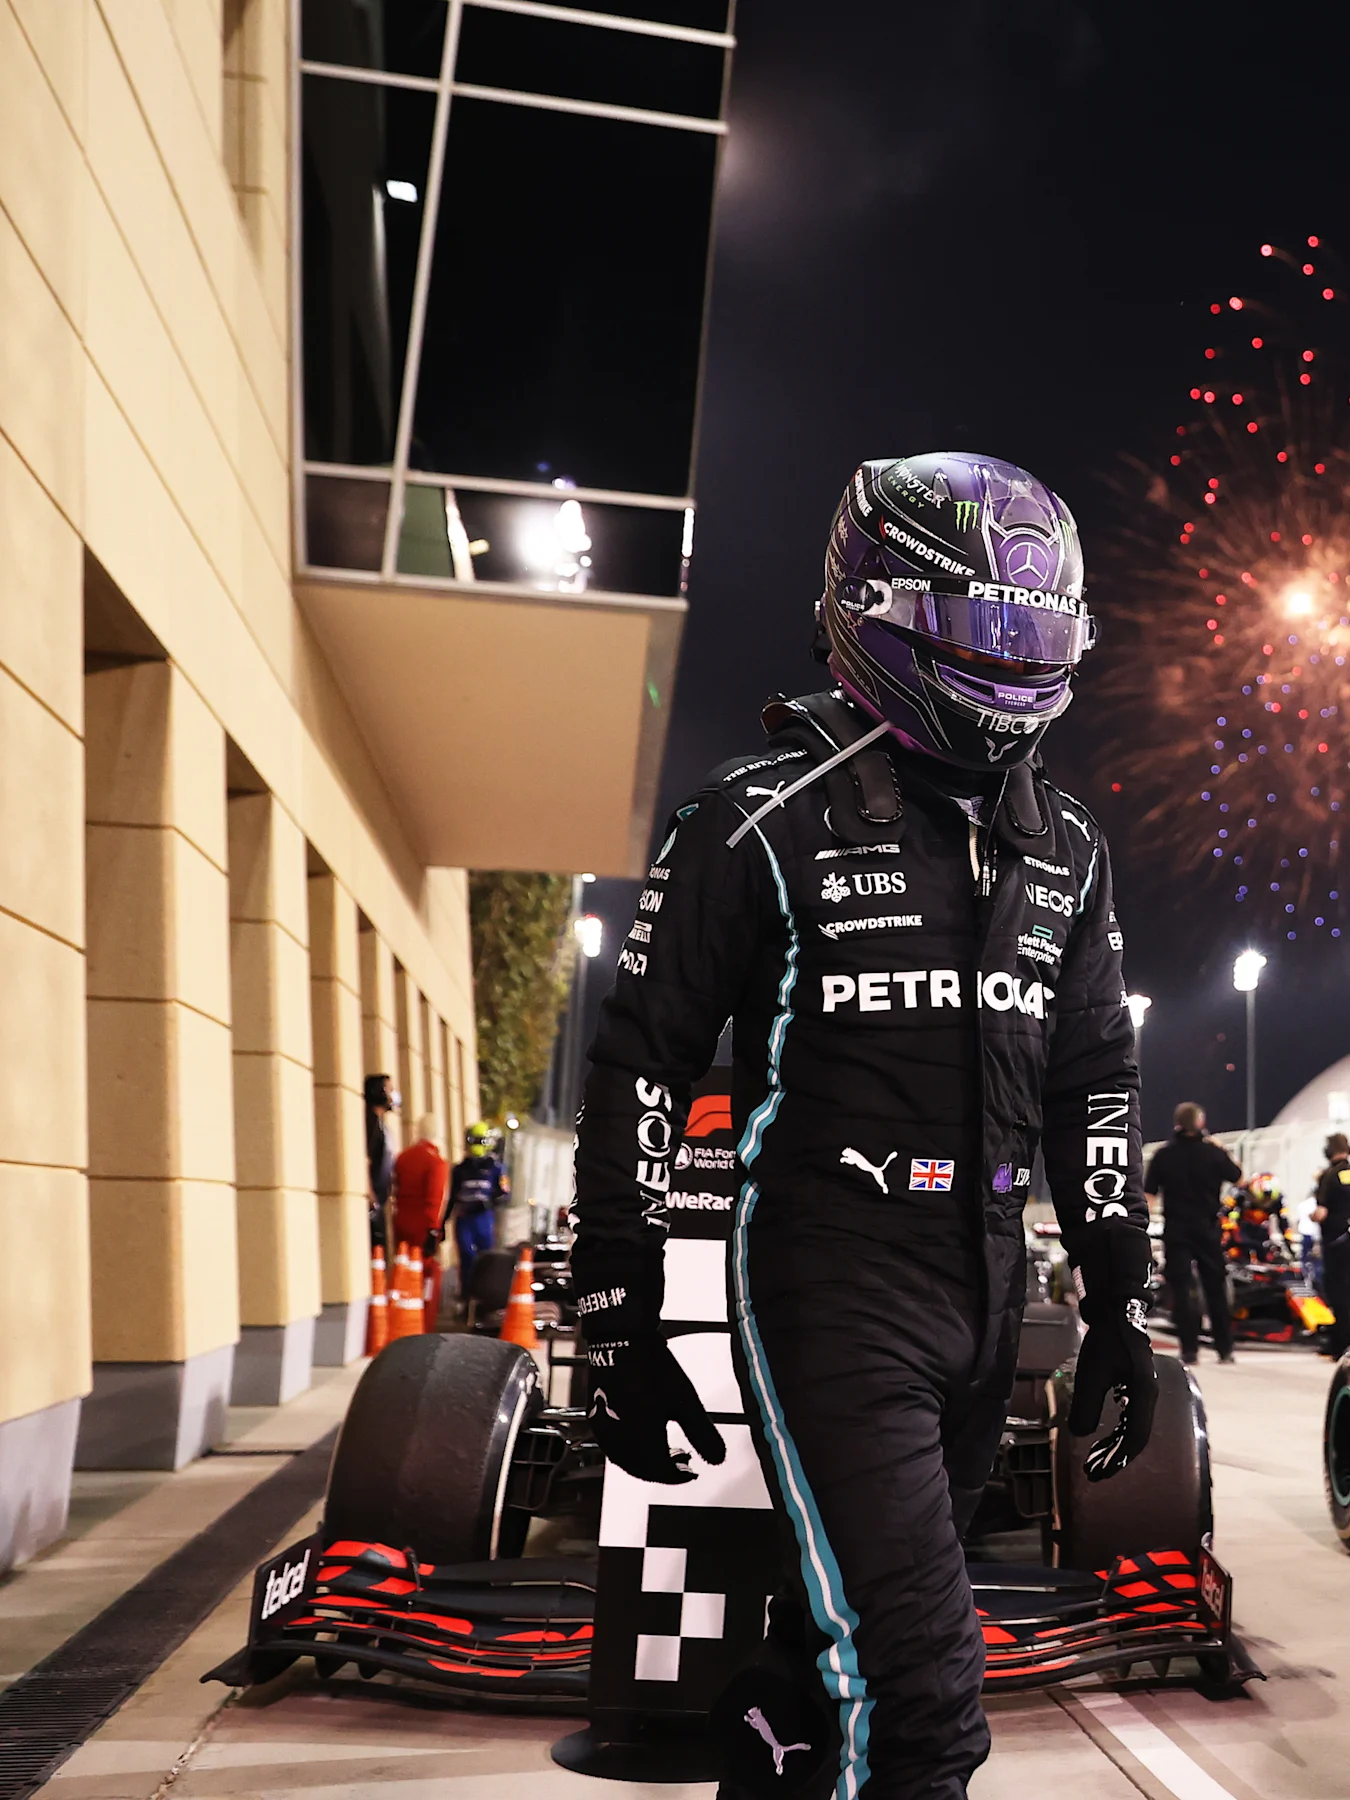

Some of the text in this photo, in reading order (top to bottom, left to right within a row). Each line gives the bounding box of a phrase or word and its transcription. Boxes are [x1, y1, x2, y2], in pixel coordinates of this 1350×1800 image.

[887, 475, 925, 509] ENERGY
[883, 521, 976, 577] CROWDSTRIKE
[891, 577, 931, 592] EPSON
[967, 580, 1077, 616] PETRONAS
[998, 691, 1034, 703] POLICE
[723, 766, 748, 782] THE
[1023, 855, 1070, 876] ETRONAS
[851, 871, 907, 896] UBS
[1025, 882, 1075, 917] NEOS
[826, 914, 923, 934] CROWDSTRIKE
[694, 1147, 714, 1158] FIA
[693, 1158, 729, 1170] World
[261, 1548, 311, 1620] telcel
